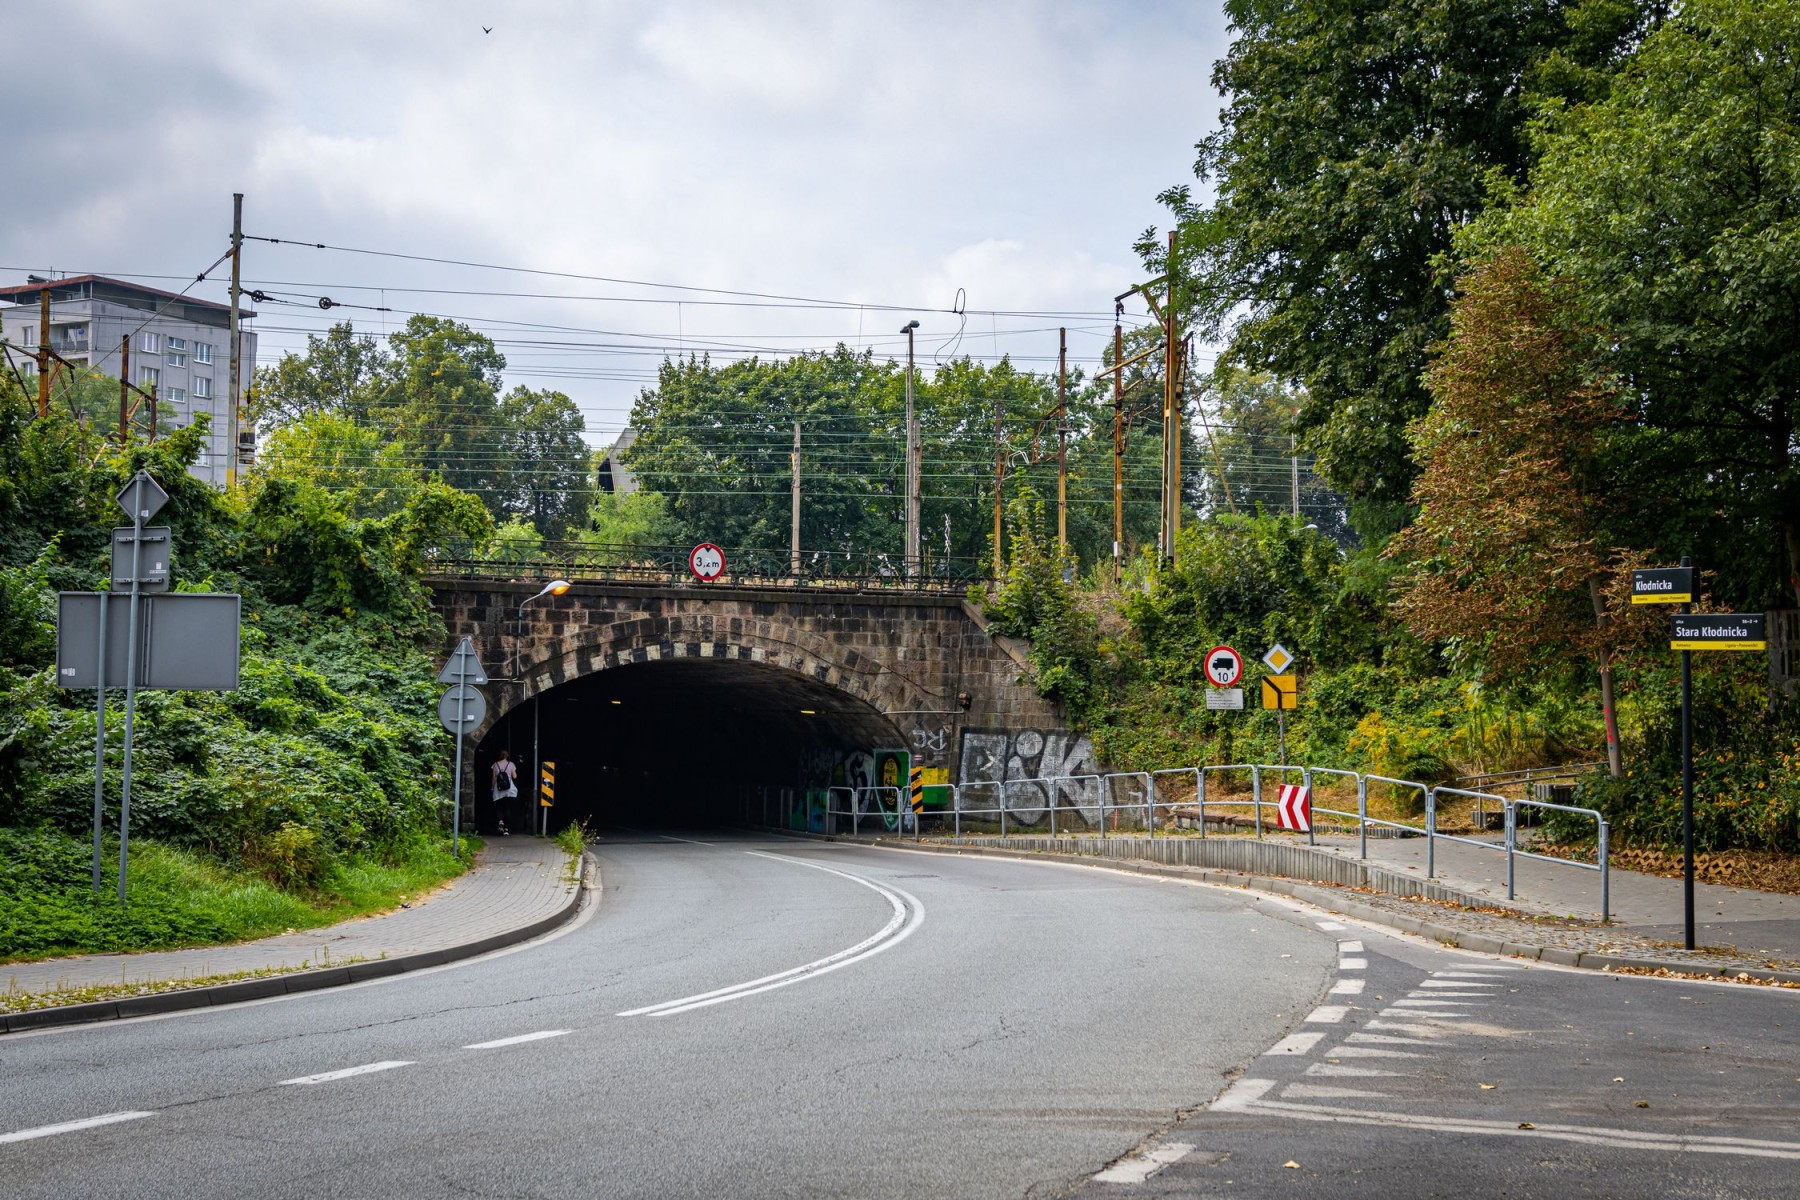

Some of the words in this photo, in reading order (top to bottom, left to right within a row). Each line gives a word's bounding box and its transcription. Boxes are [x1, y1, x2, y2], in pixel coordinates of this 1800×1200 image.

[1636, 580, 1672, 591] Kłodnicka
[1676, 627, 1699, 637] Stara
[1702, 626, 1748, 637] Kłodnicka
[1218, 672, 1229, 682] 10
